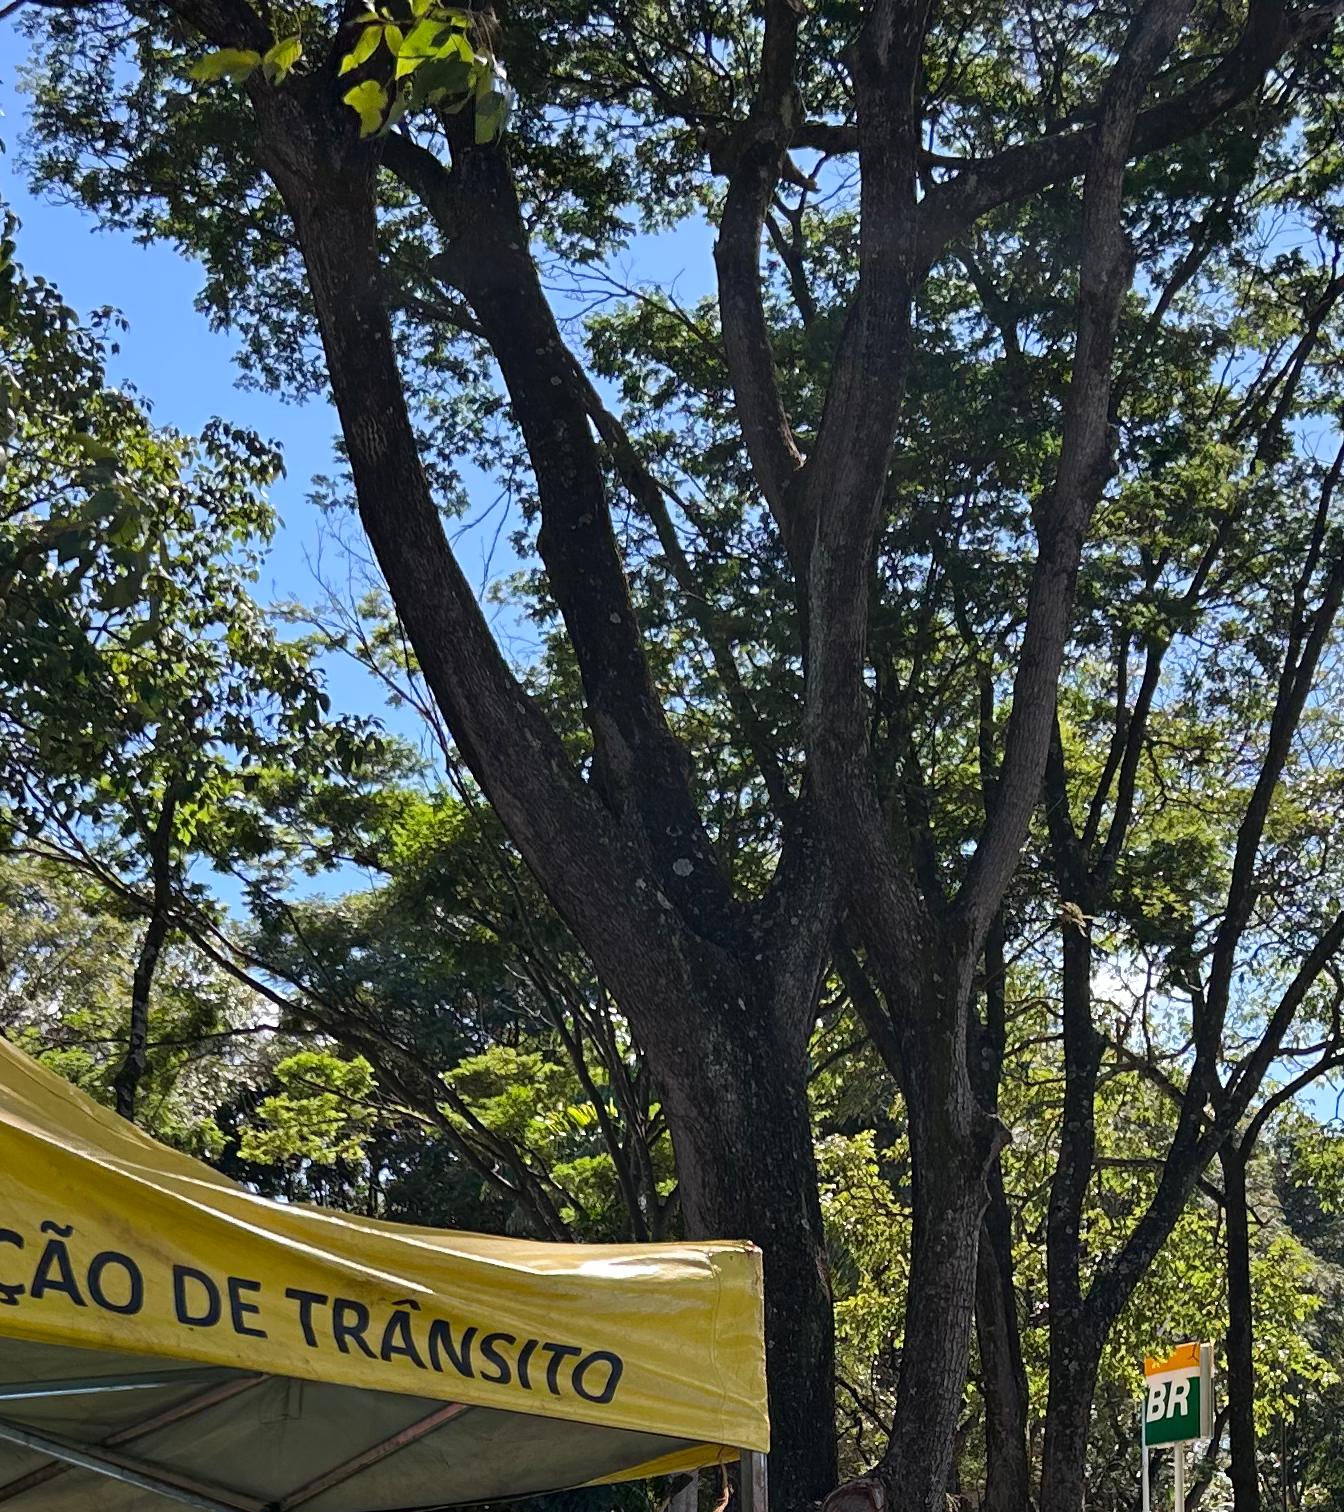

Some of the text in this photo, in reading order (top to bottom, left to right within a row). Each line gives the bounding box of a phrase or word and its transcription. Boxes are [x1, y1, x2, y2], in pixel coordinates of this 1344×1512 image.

[172, 1263, 268, 1338] DE
[284, 1286, 624, 1405] TRÂNSITO
[1145, 1377, 1192, 1424] BR
